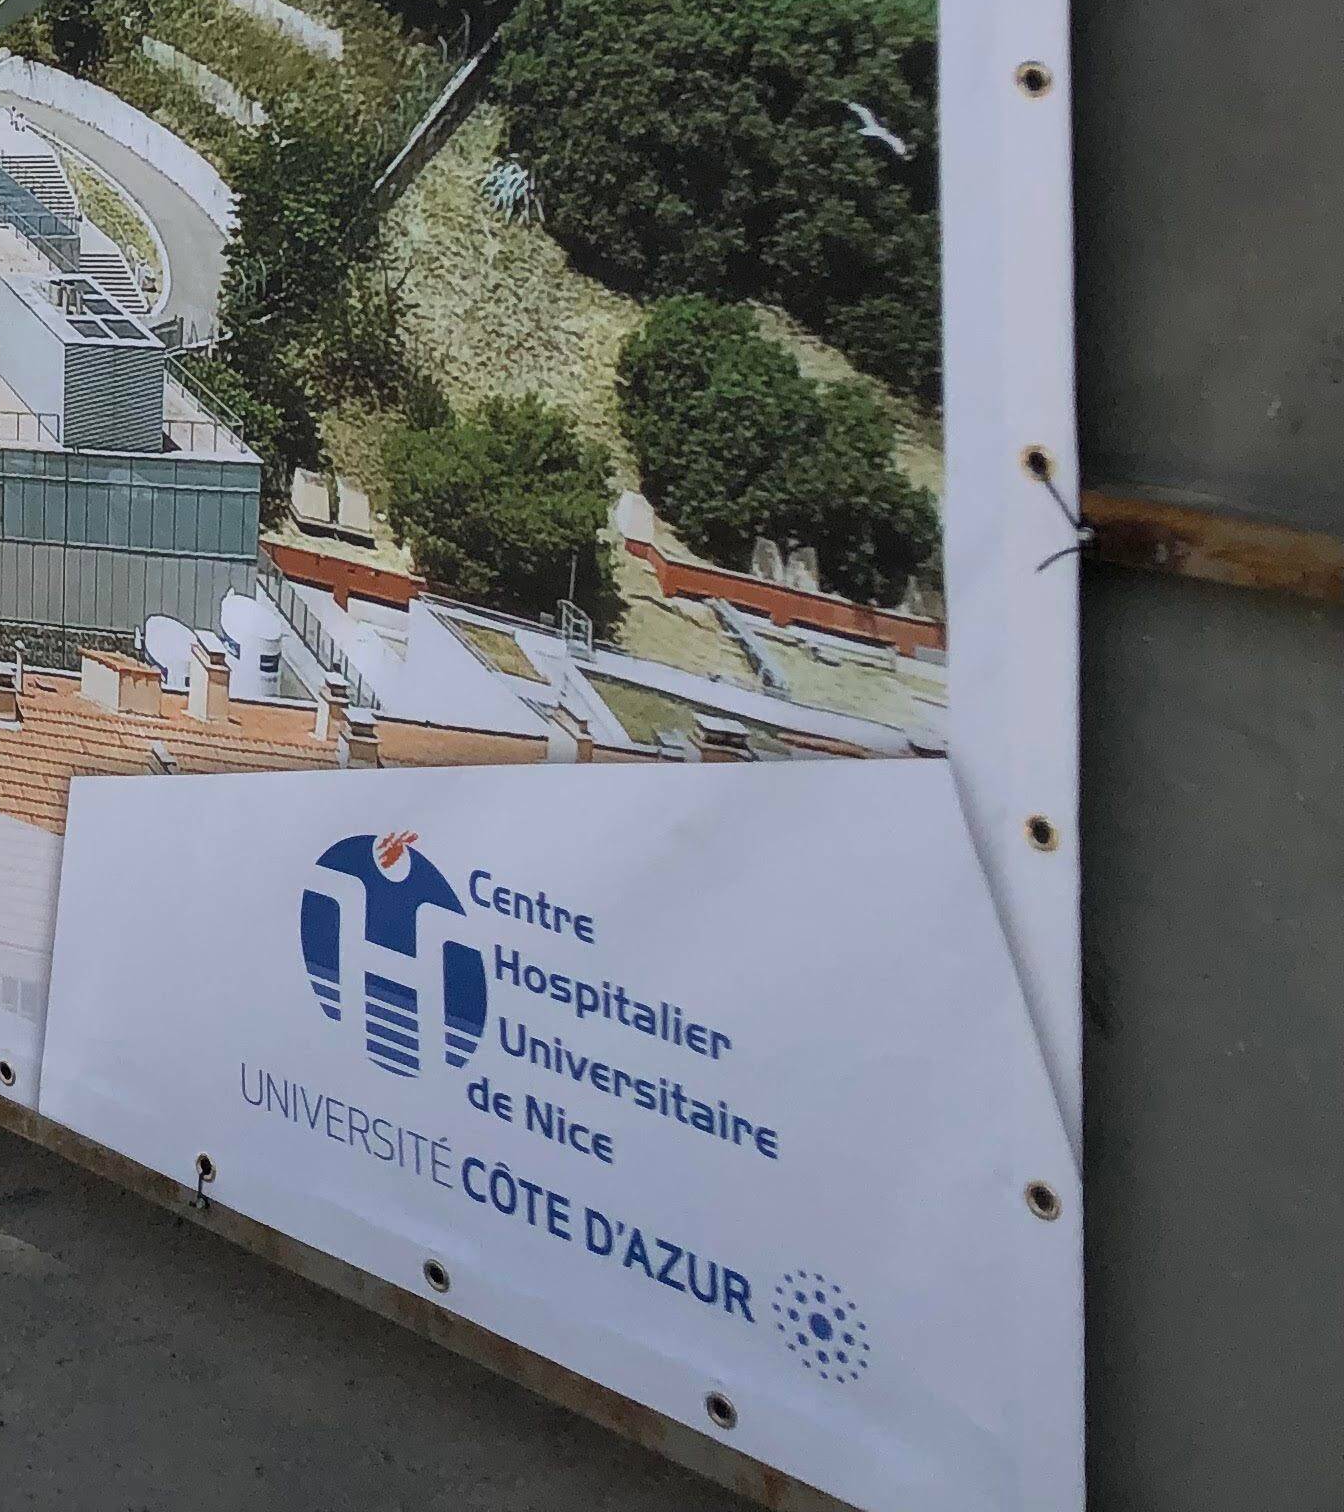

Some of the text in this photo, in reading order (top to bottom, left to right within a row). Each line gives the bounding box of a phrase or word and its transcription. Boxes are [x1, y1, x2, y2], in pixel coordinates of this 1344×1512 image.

[469, 869, 596, 945] Centre
[494, 944, 733, 1060] Hospitalier
[467, 1077, 614, 1164] de Nice
[499, 1017, 779, 1160] Universitaire
[241, 1062, 756, 1323] UNIVERSITÉ CÔTE D'AZUR
